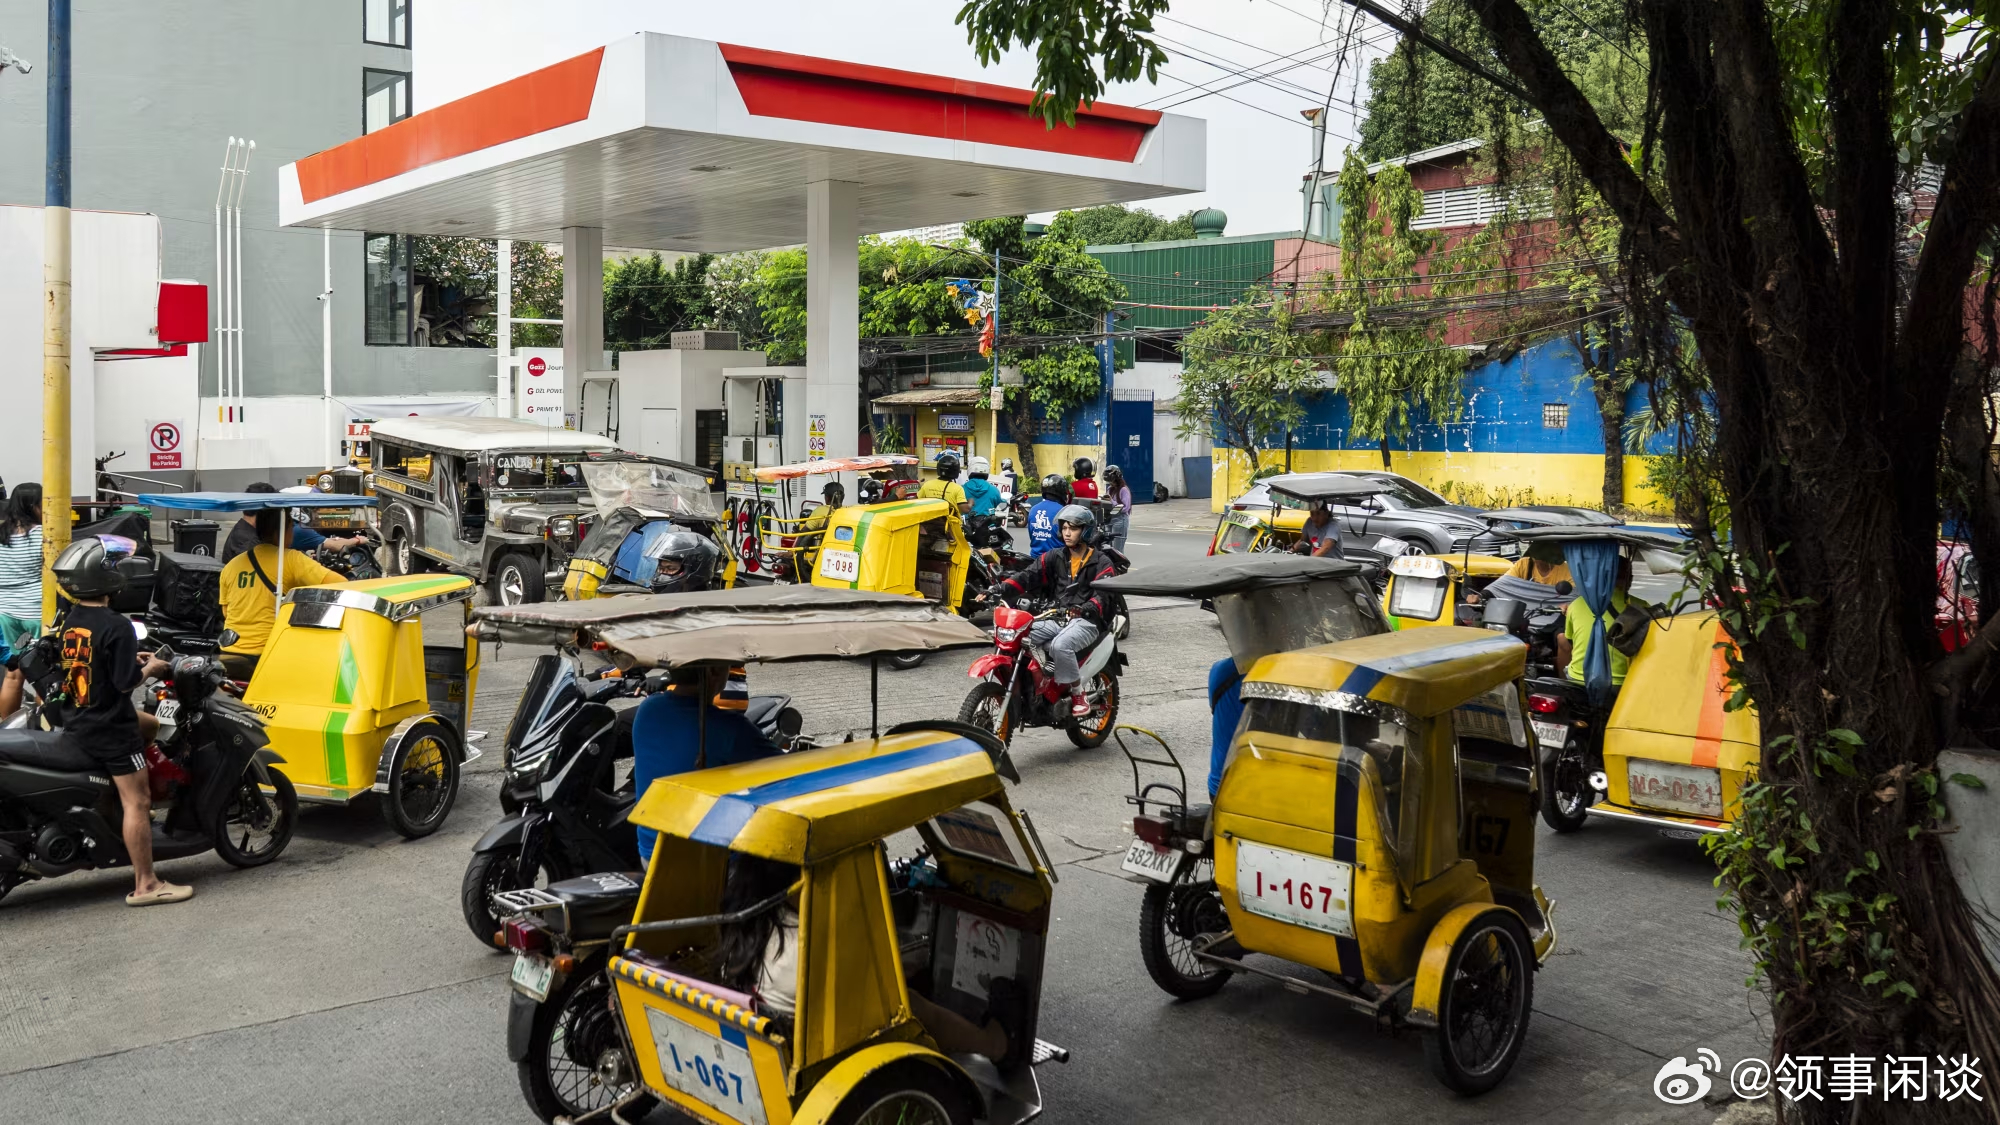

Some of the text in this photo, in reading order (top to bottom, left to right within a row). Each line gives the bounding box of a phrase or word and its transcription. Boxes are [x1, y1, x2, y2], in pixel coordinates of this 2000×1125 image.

[528, 363, 546, 371] Gazz
[946, 418, 968, 426] LOTTO
[497, 456, 533, 469] CANLAS
[826, 558, 854, 574] T-098
[237, 570, 257, 589] 61
[88, 774, 110, 786] YAMAHA
[1126, 846, 1177, 874] 382XKY
